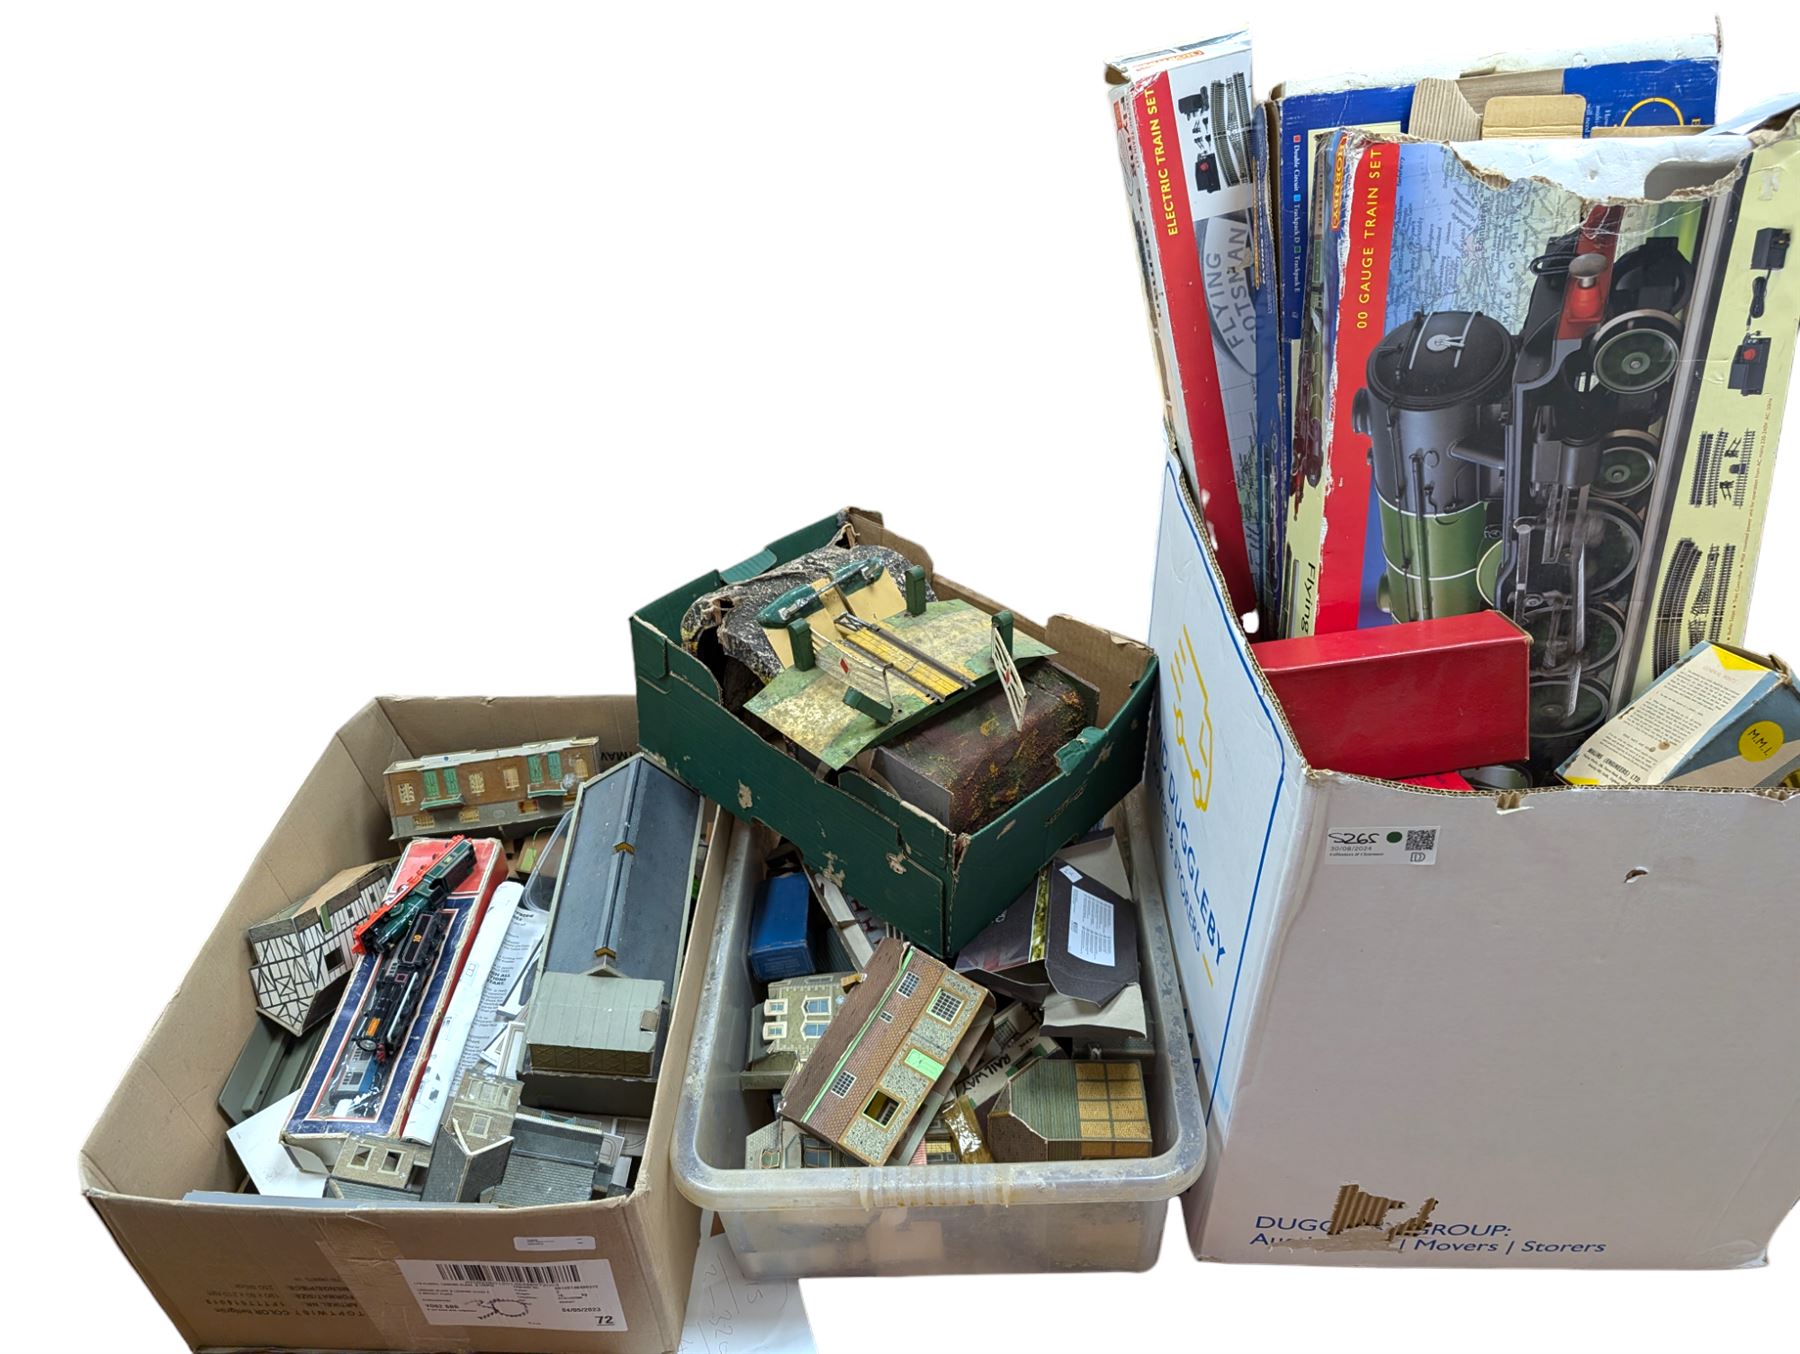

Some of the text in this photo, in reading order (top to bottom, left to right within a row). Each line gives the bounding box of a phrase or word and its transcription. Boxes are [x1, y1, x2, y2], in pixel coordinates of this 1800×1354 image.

[1144, 86, 1158, 113] SET
[1149, 117, 1168, 168] TRAIN
[1370, 150, 1383, 186] SET
[1156, 168, 1178, 236] ELECTRIC
[1363, 192, 1380, 241] TRAIN
[1205, 251, 1237, 349] FLYING
[1358, 247, 1374, 304] GAUGE
[1300, 561, 1316, 633] Flying
[1168, 772, 1226, 966] DUGGLEBY
[1172, 847, 1202, 953] STORERS
[961, 1053, 1011, 1096] RAILWAY
[1413, 1239, 1608, 1253] Movers Storers
[595, 1315, 614, 1325] 72
